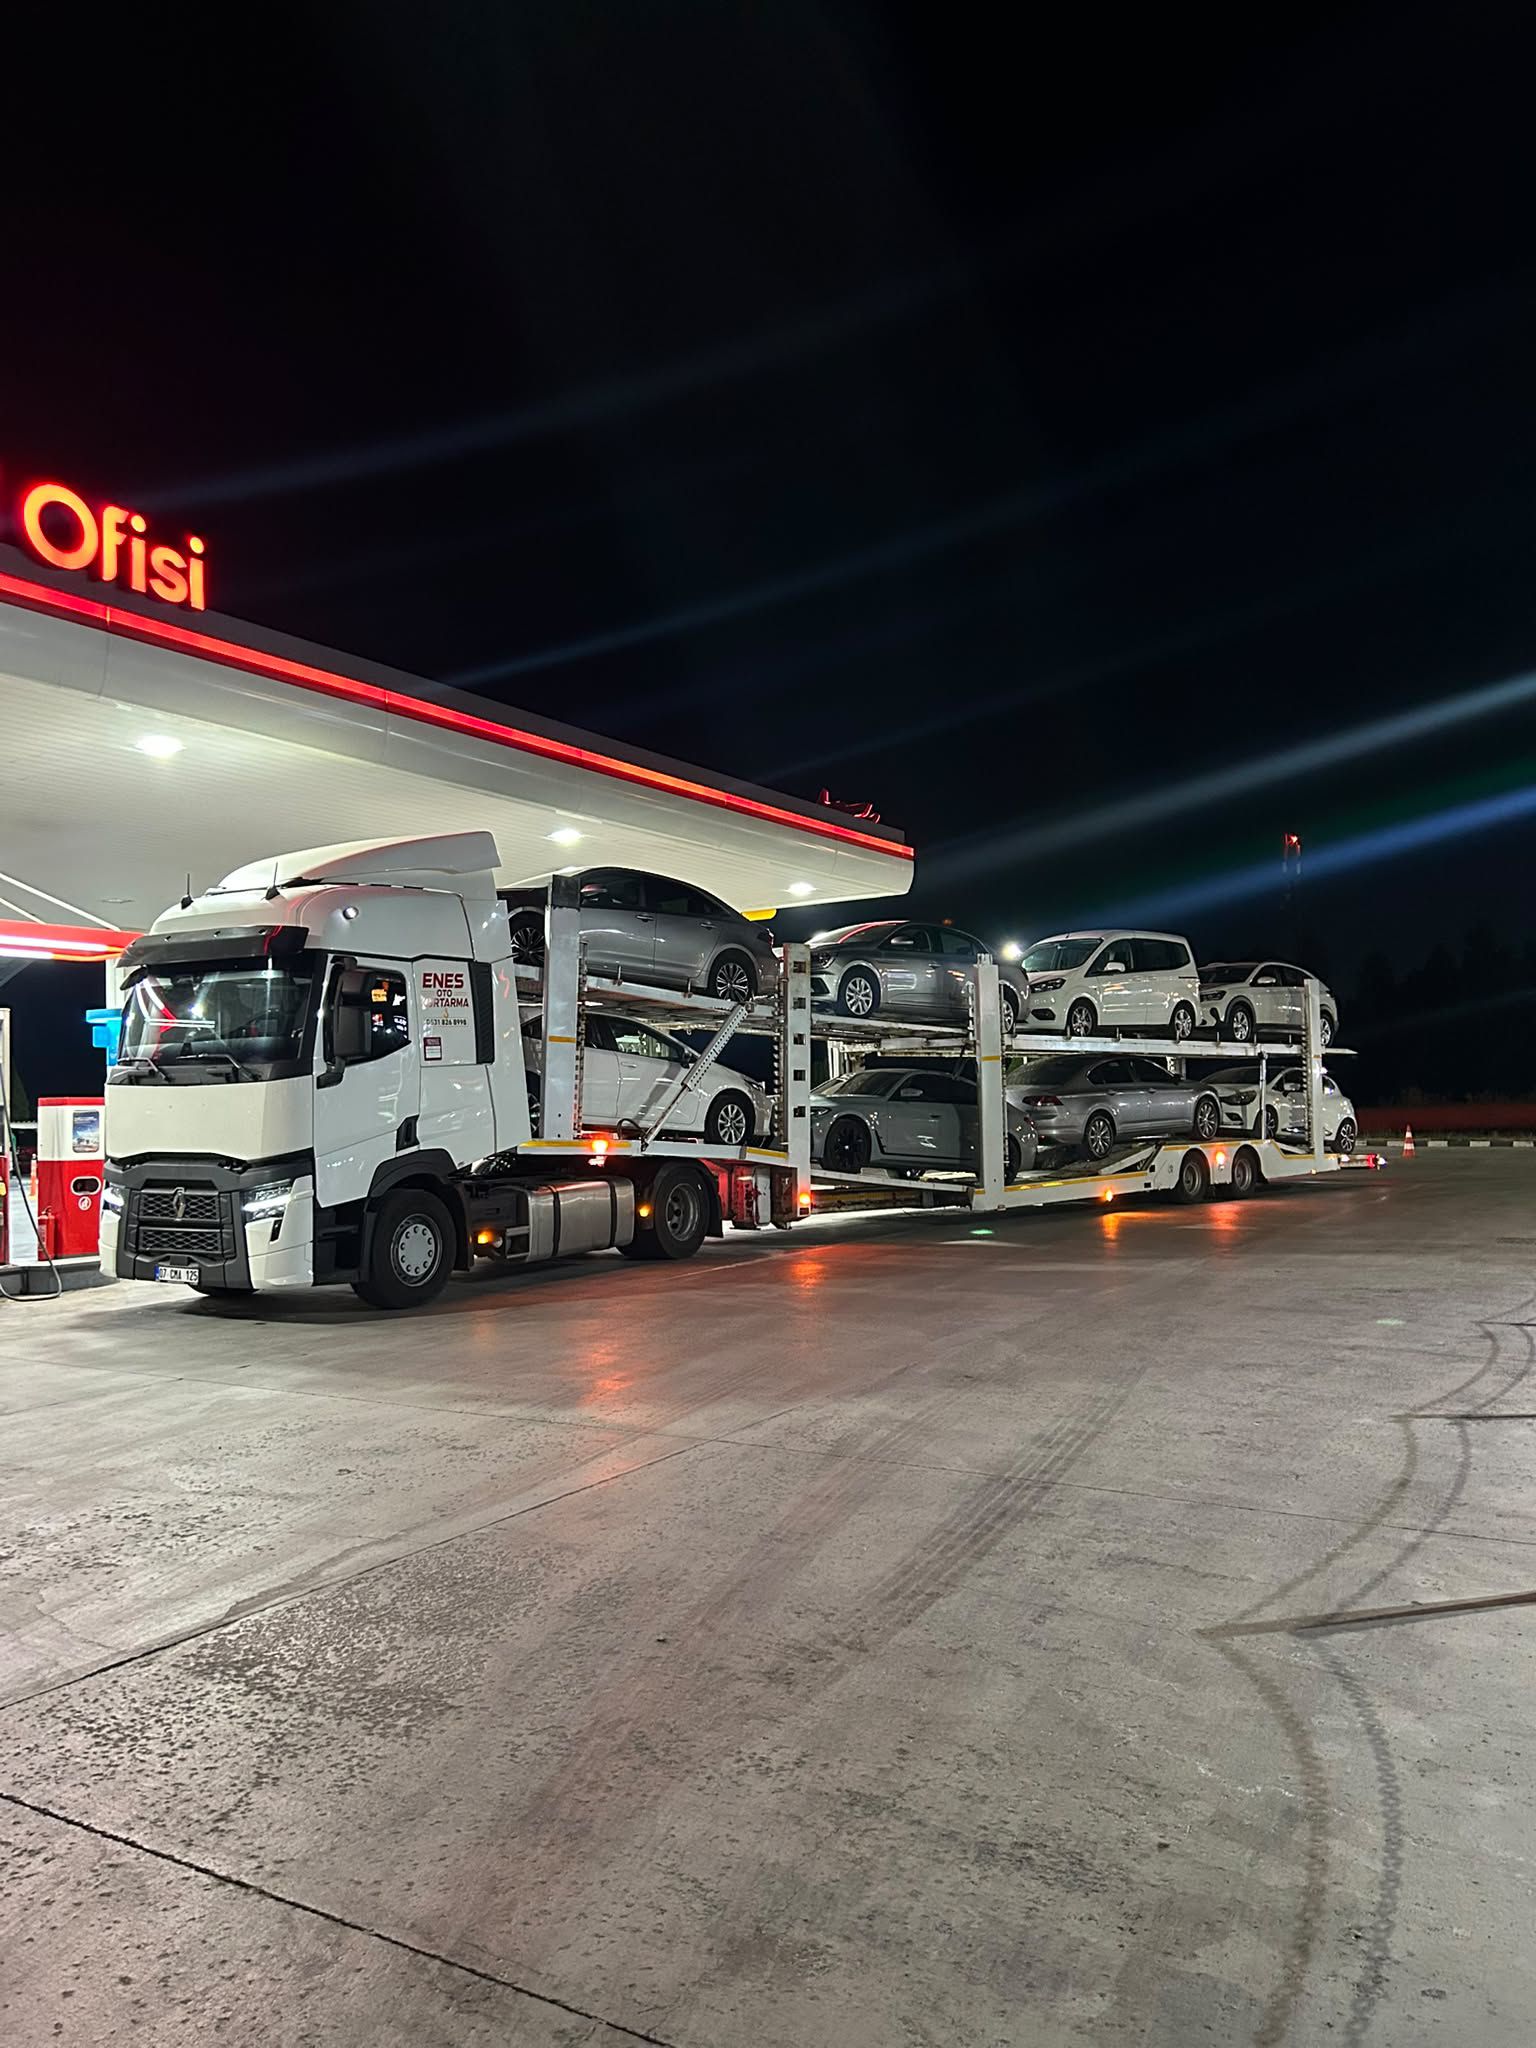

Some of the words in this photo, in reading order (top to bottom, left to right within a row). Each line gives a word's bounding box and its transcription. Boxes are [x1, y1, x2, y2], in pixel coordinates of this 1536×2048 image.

[23, 483, 206, 612] Ofisi
[422, 972, 464, 989] ENES
[436, 989, 453, 998] OTO
[421, 997, 469, 1008] URTARMA
